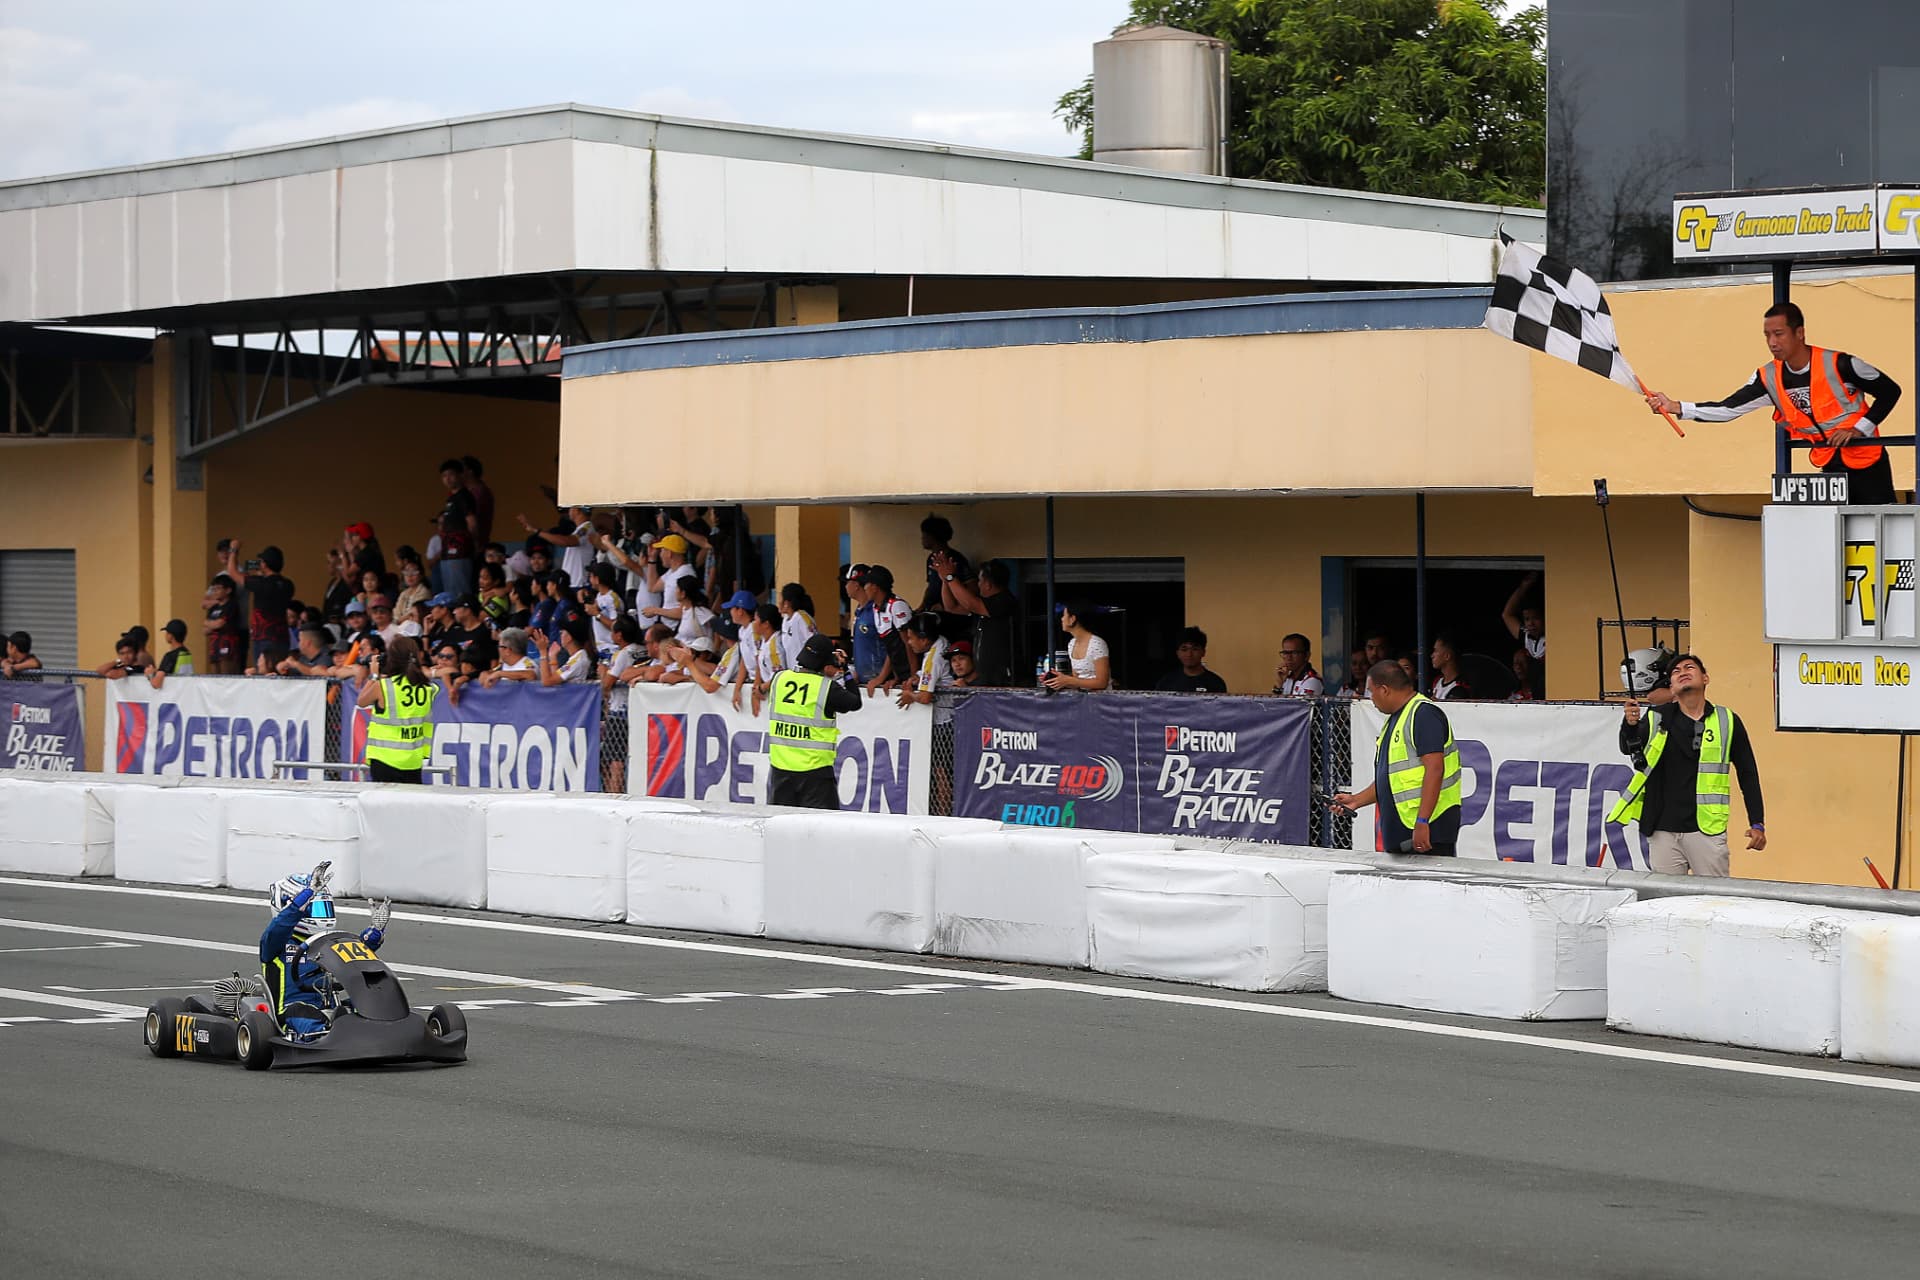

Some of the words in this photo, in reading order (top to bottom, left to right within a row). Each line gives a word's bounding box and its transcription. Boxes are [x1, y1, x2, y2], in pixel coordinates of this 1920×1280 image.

[1734, 211, 1797, 238] Carmona
[1798, 207, 1833, 235] Race
[1835, 203, 1873, 232] Track
[1772, 477, 1808, 502] LAP'S
[1810, 477, 1827, 502] TO
[1829, 477, 1847, 502] GO
[1799, 652, 1863, 686] Carmona
[1874, 655, 1911, 686] Race
[401, 685, 428, 707] 30
[782, 680, 809, 706] 21
[20, 704, 51, 724] PETRON
[6, 724, 66, 757] BLAZE
[154, 702, 309, 780] PETRON
[775, 722, 812, 740] MEDIA
[993, 728, 1038, 751] PETRON
[1180, 727, 1237, 753] PETRON
[1705, 729, 1714, 743] 3
[431, 722, 588, 792] ETRON
[694, 713, 912, 815] PEON
[974, 752, 1061, 790] BLAZE
[1058, 765, 1107, 789] 100
[1156, 754, 1264, 798] BLAZE
[1001, 803, 1060, 827] EURO
[1172, 794, 1283, 829] RACING
